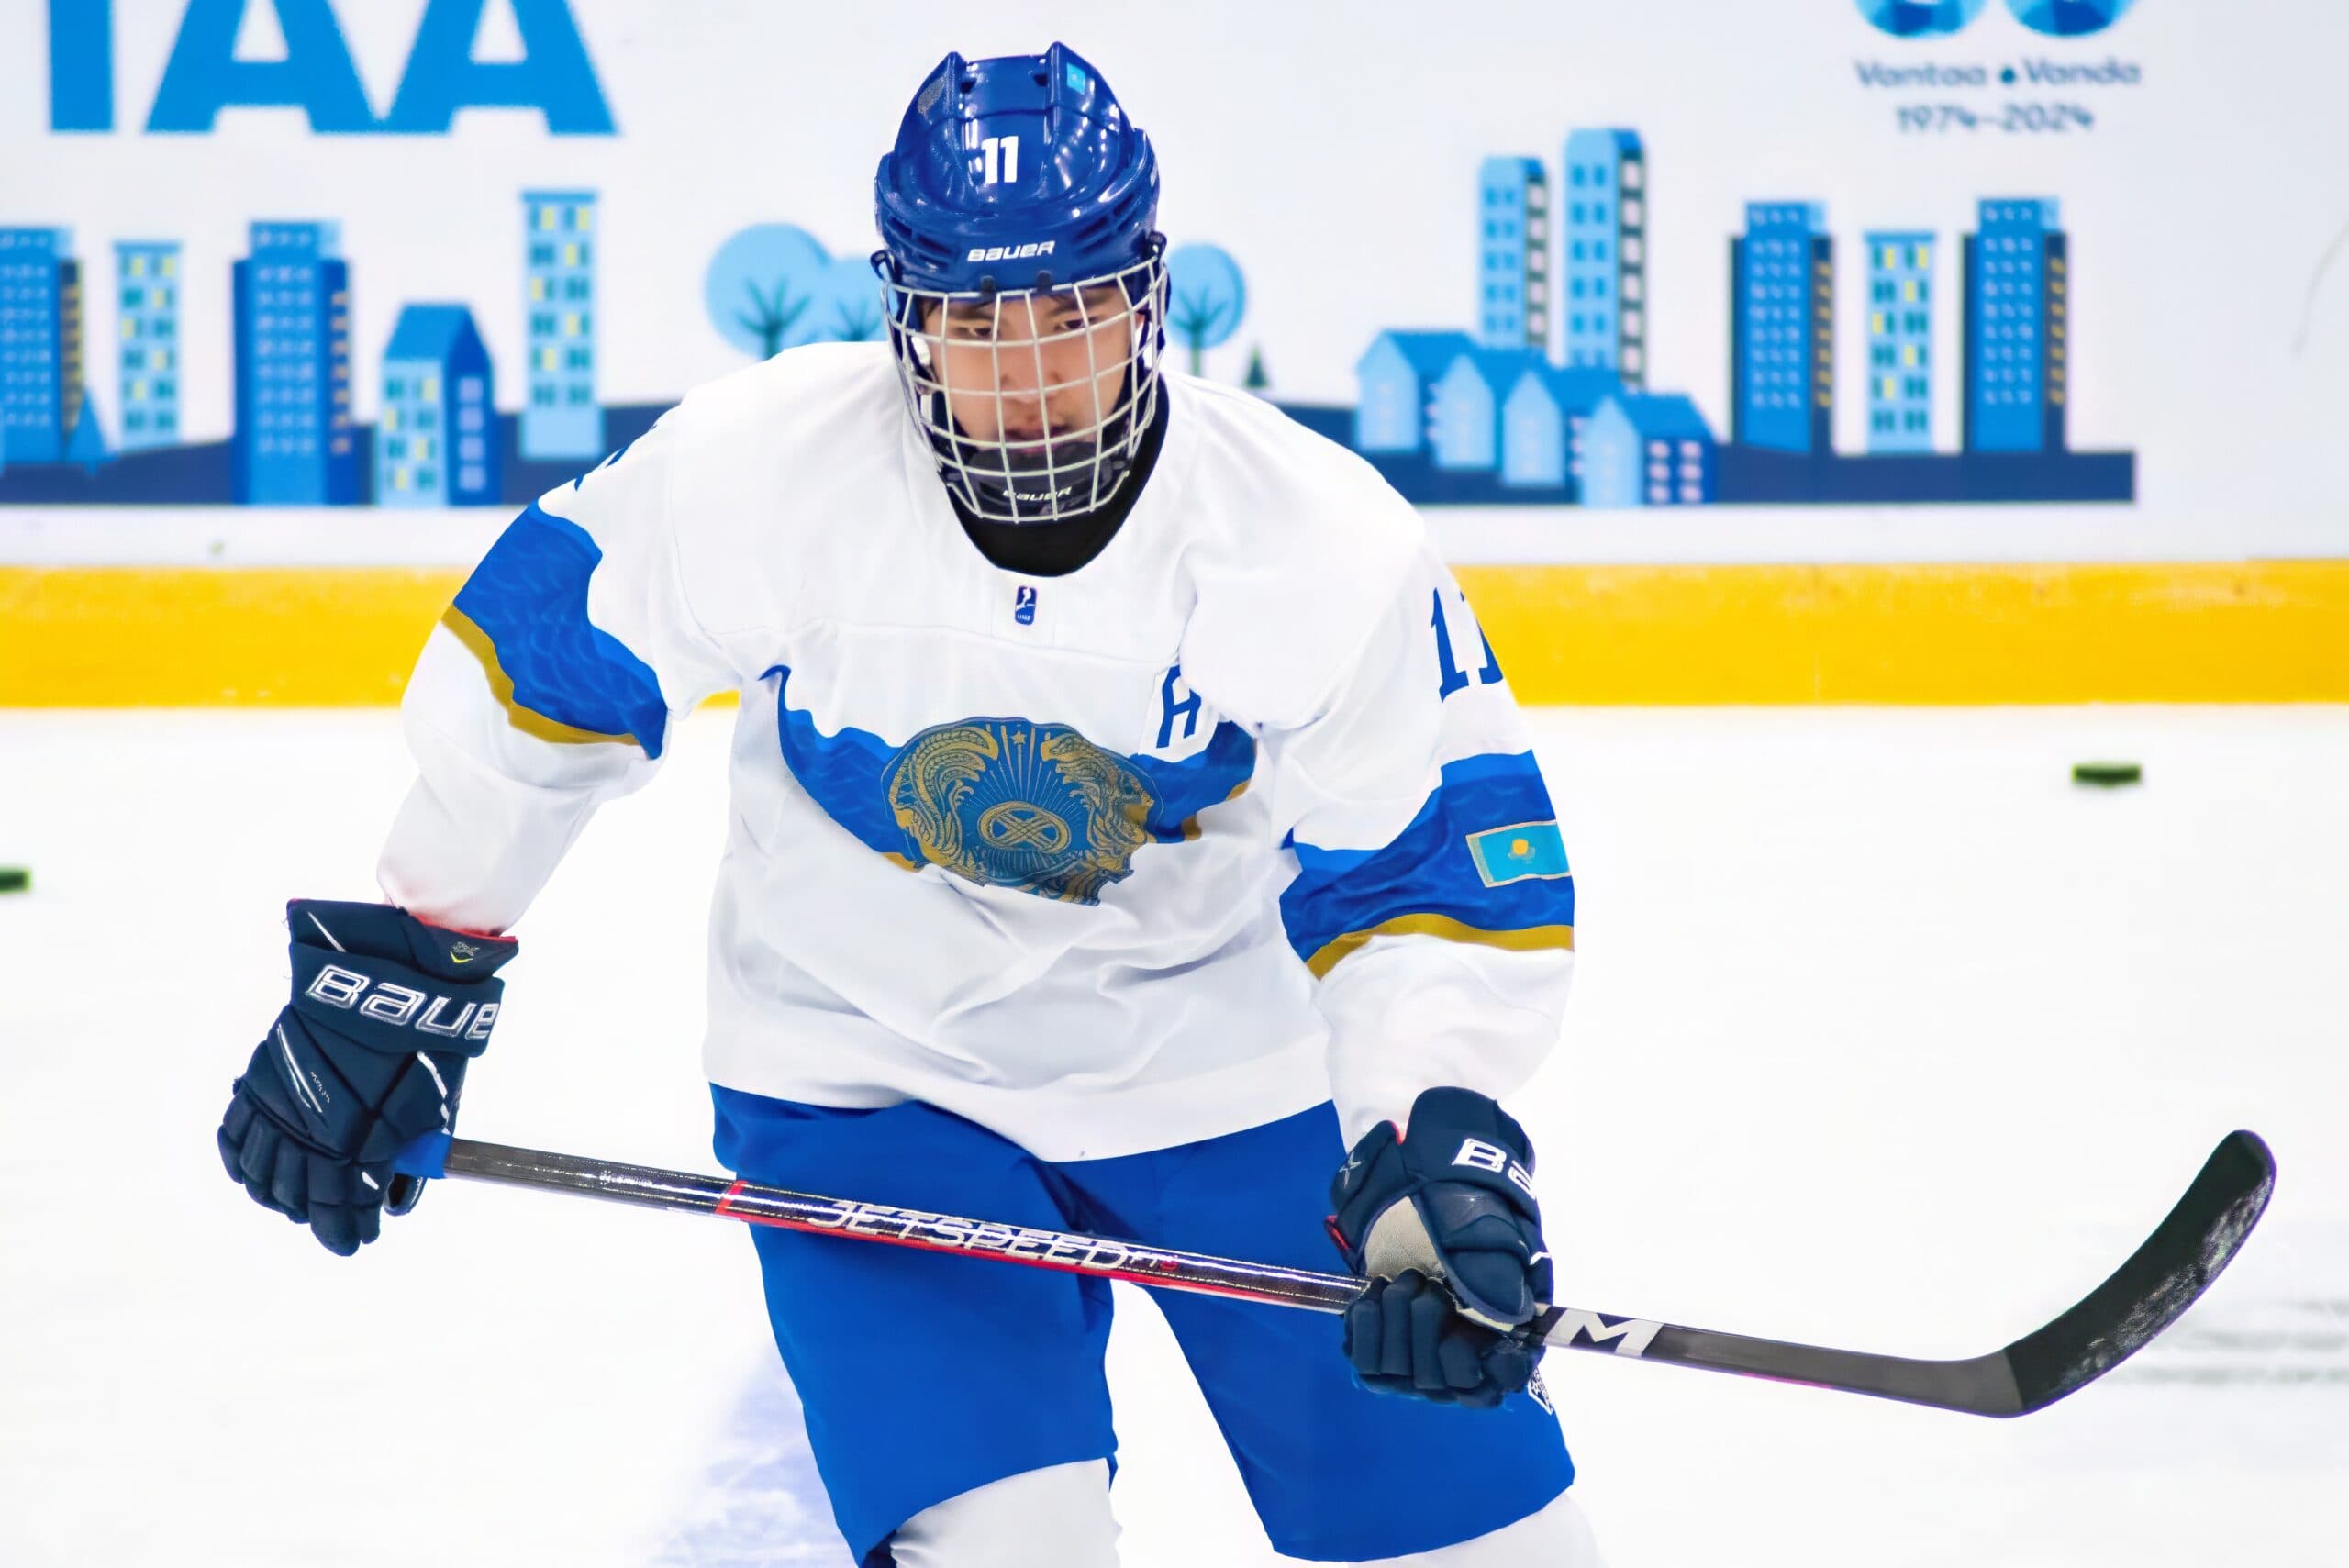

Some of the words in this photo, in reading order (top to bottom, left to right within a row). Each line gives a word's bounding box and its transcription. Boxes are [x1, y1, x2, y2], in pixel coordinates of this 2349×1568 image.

[1854, 59, 1987, 87] Vantaa
[2023, 55, 2143, 86] Vanda
[981, 136, 1019, 184] 11
[807, 1200, 1128, 1271] JETSPEED
